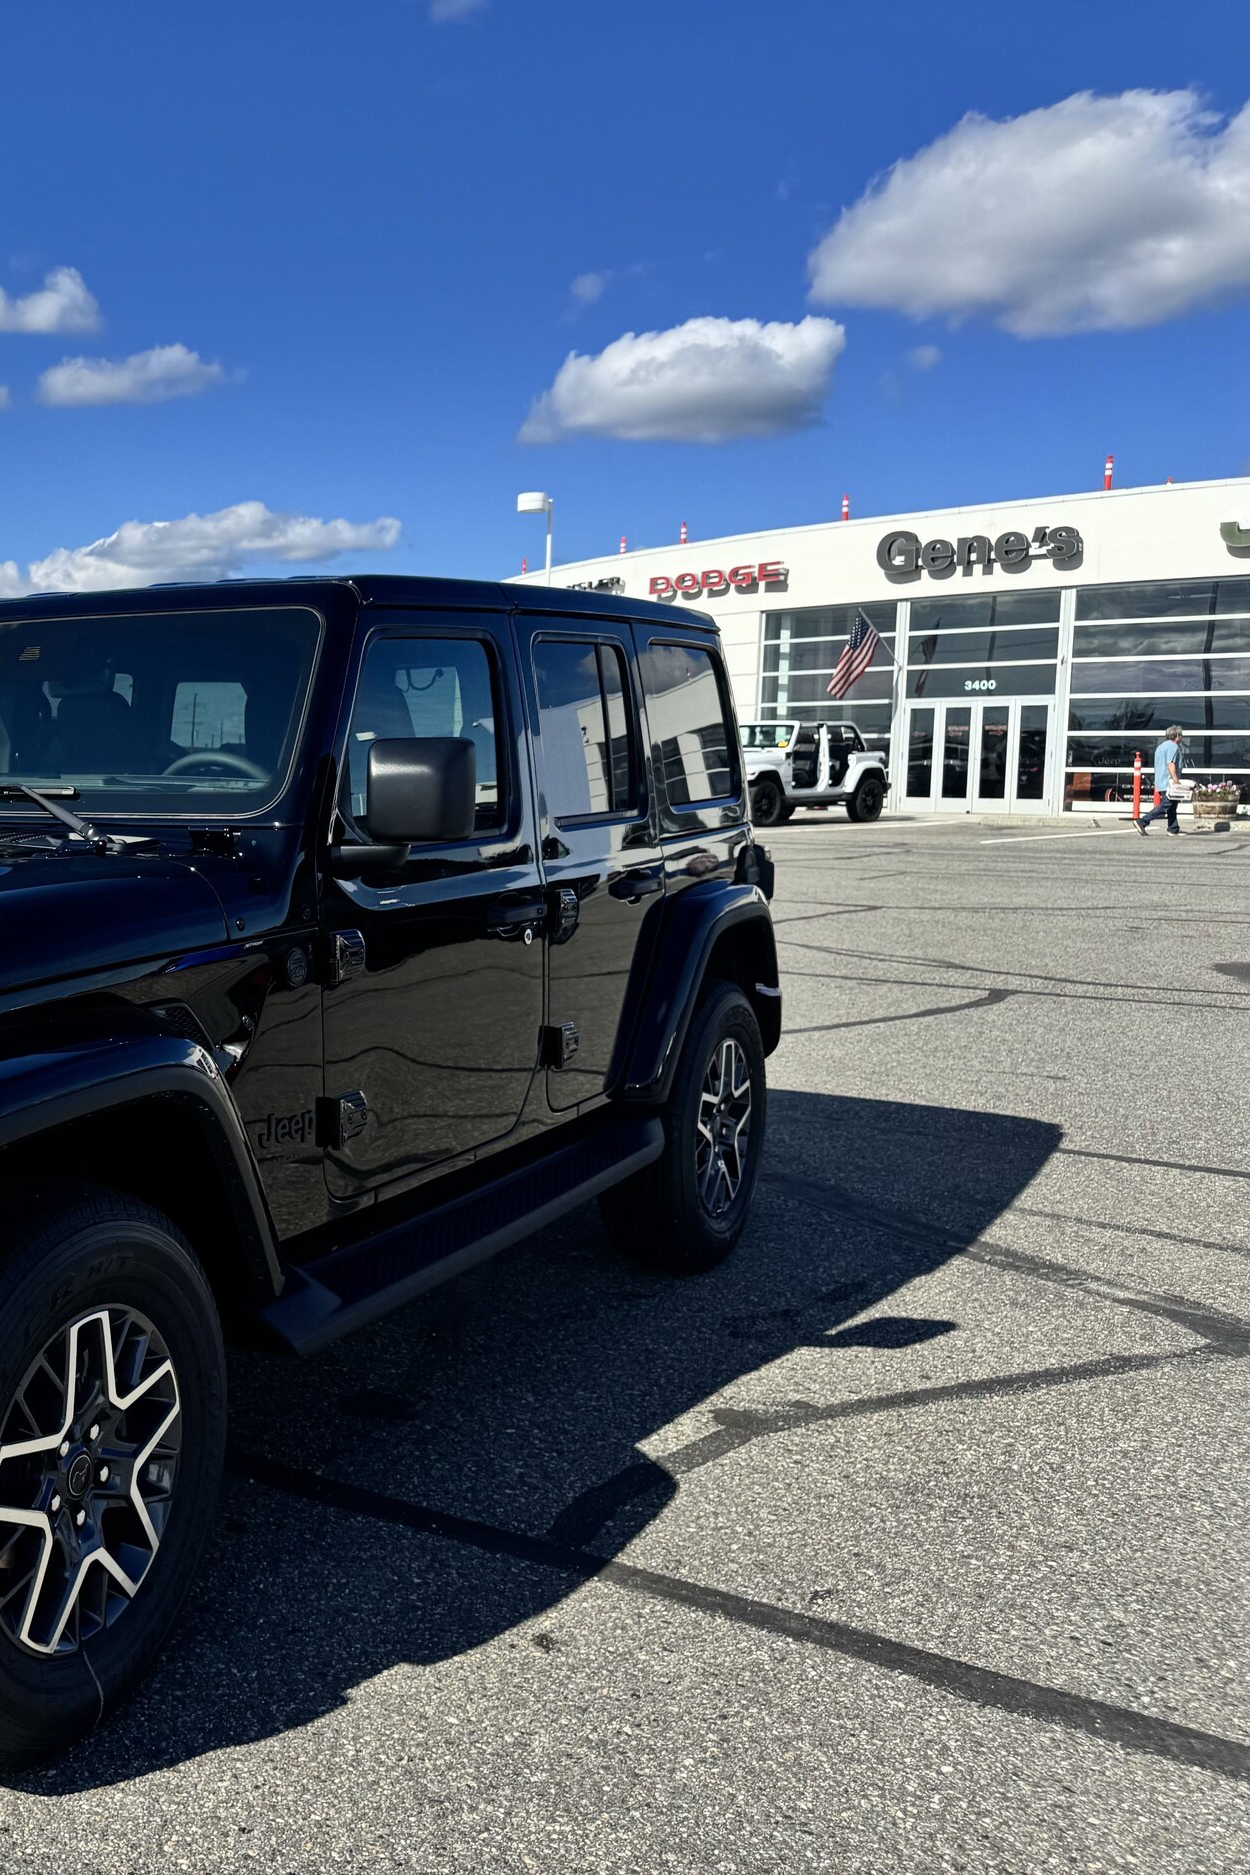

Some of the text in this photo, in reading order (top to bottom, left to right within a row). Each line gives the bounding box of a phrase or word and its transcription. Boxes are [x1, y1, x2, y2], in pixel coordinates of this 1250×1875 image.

[876, 526, 1079, 575] Gene's
[648, 561, 785, 596] DODGE
[964, 679, 996, 691] 3400
[258, 1109, 315, 1149] Jeep
